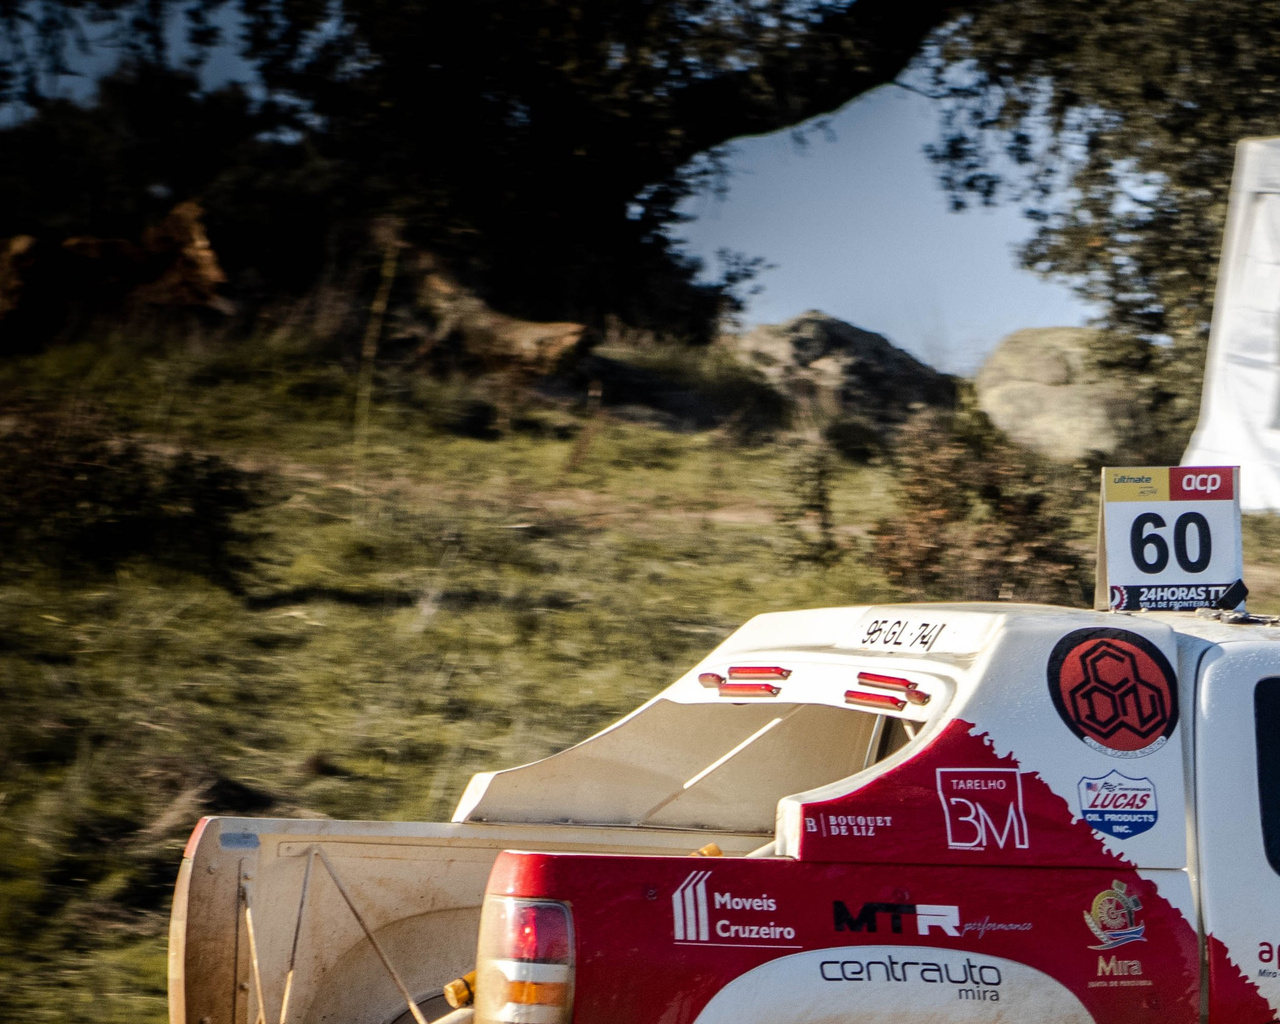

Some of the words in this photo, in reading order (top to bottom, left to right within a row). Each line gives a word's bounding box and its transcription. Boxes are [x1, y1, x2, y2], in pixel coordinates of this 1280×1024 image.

[1182, 474, 1221, 493] acp
[1131, 512, 1212, 574] 60
[951, 779, 1006, 790] TARELHO
[1089, 793, 1151, 809] LUCAS
[804, 817, 818, 833] B
[828, 815, 892, 827] BOUQUET
[1085, 813, 1102, 822] OIL
[1104, 813, 1155, 823] PRODUCTS
[830, 825, 849, 836] DE
[852, 826, 876, 837] LIZ
[714, 892, 777, 911] Moveis
[833, 901, 961, 937] MTR
[716, 920, 796, 940] Cruzeiro
[820, 955, 1002, 986] centrauto
[1097, 955, 1142, 976] Mira
[958, 986, 1000, 1001] mira
